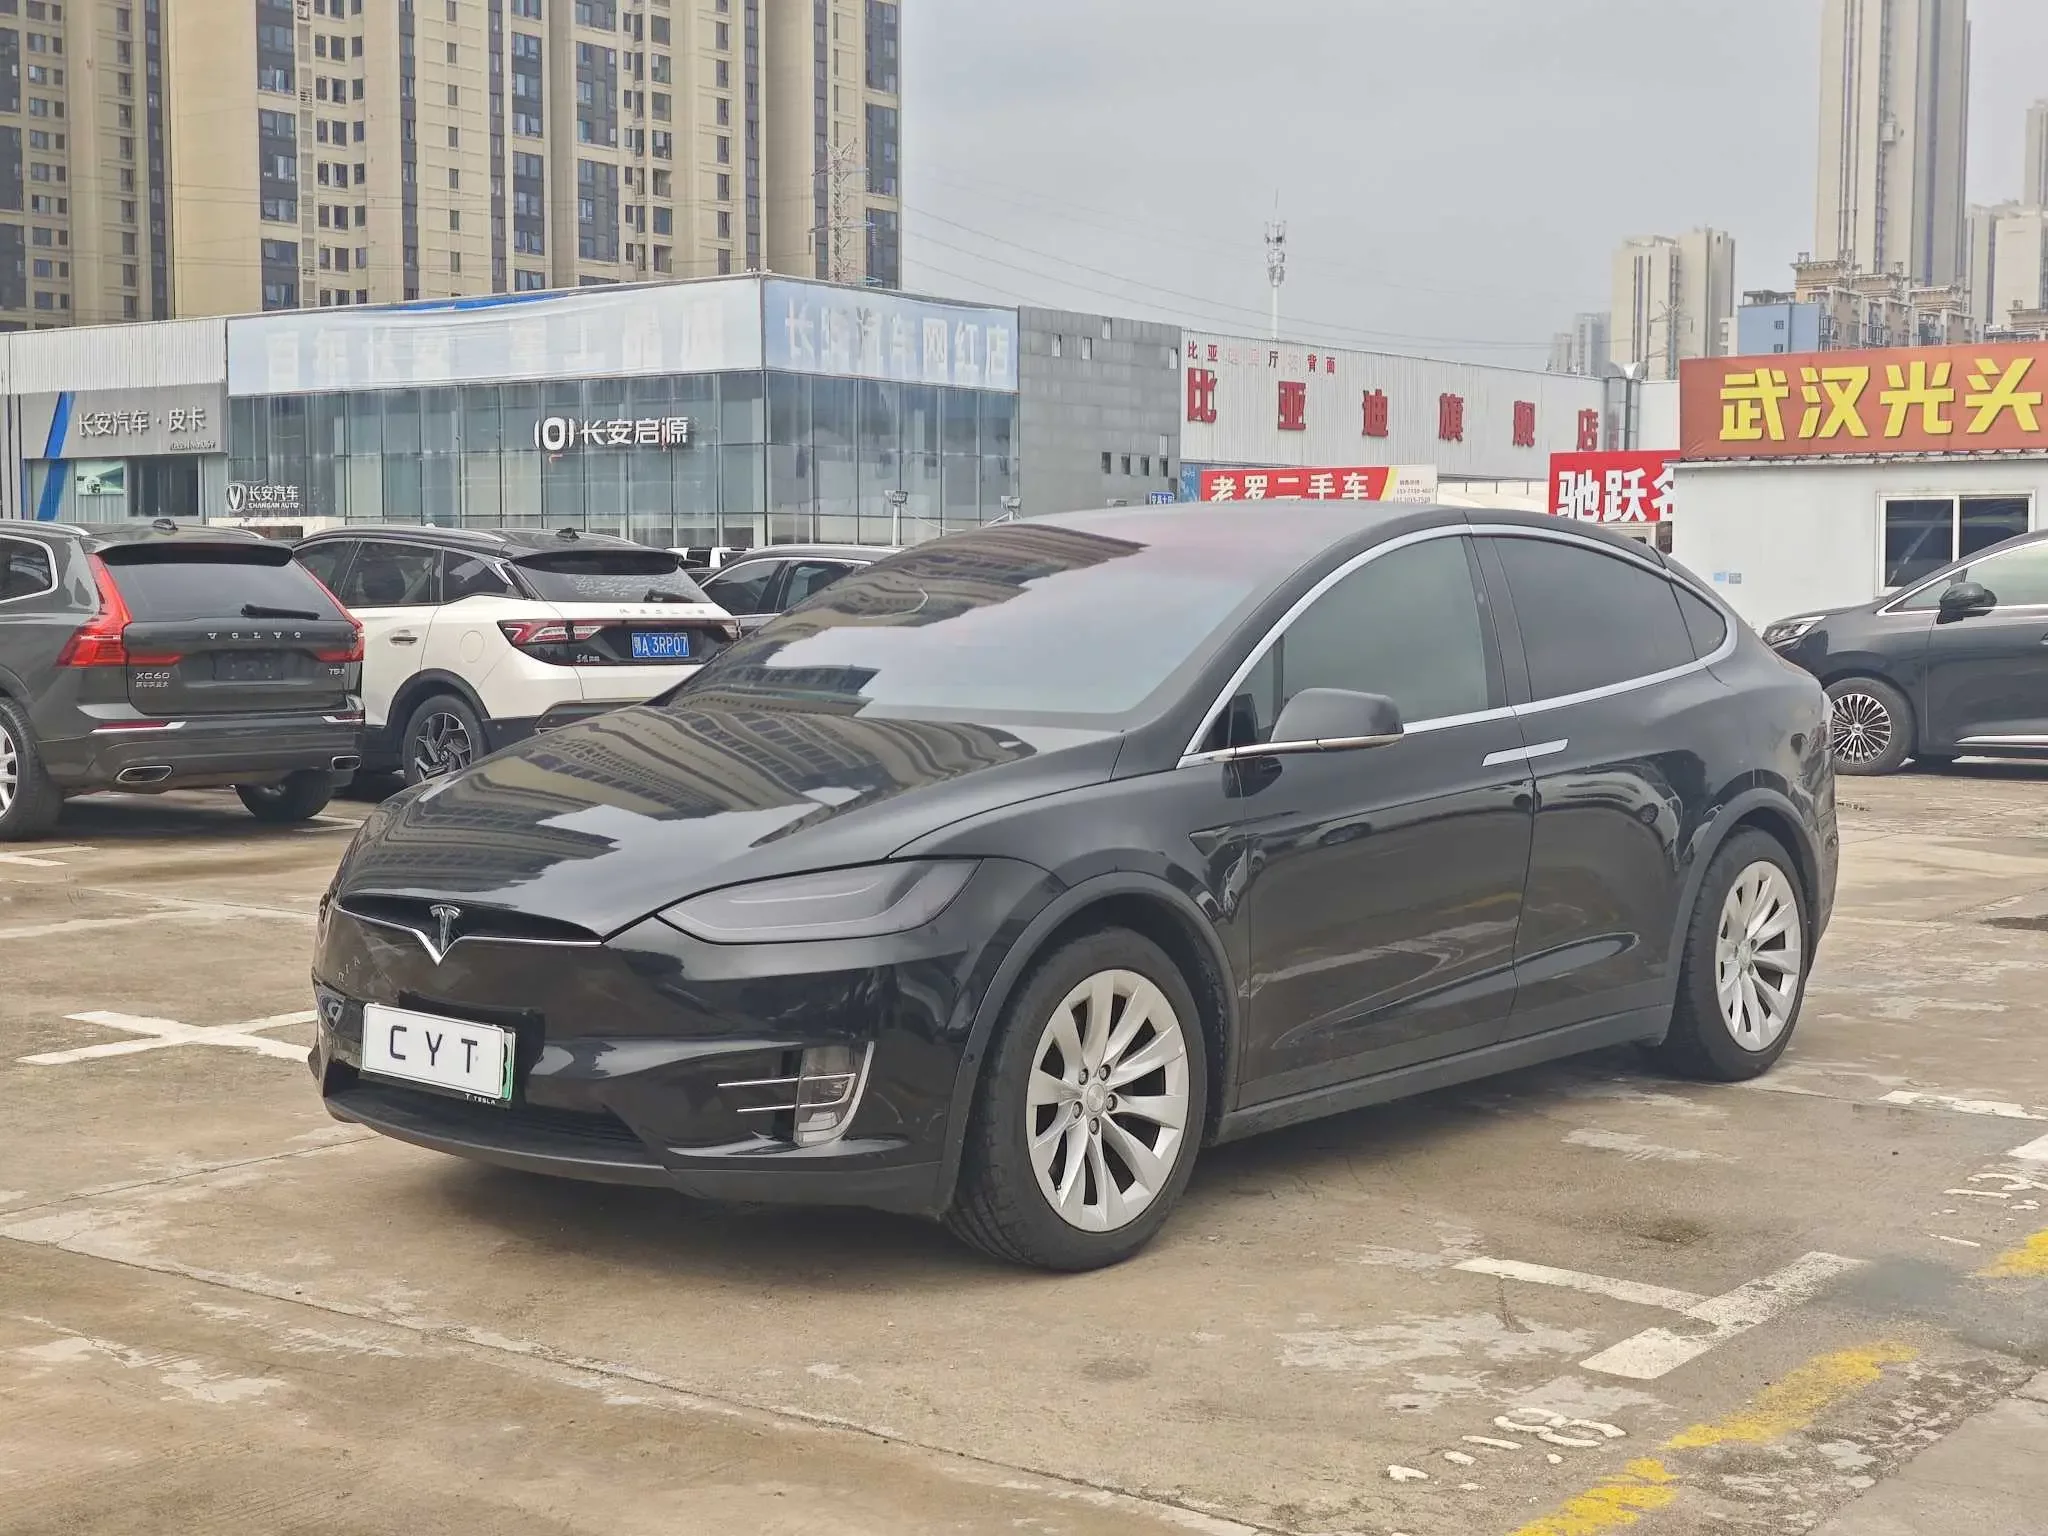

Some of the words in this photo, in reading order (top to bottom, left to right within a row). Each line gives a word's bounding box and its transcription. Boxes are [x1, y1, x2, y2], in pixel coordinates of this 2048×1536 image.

[1187, 340, 1336, 375] 比亚厅背面
[1186, 367, 1599, 451] 比亚迪旗舰店
[1719, 357, 2042, 441] 武汉光头
[580, 416, 689, 446] 长安启源
[249, 485, 299, 501] 长安汽车
[1210, 471, 1369, 503] 老罗二手车
[207, 631, 302, 640] VOLVO
[135, 672, 170, 680] XC60
[473, 1096, 496, 1105] TESLA
